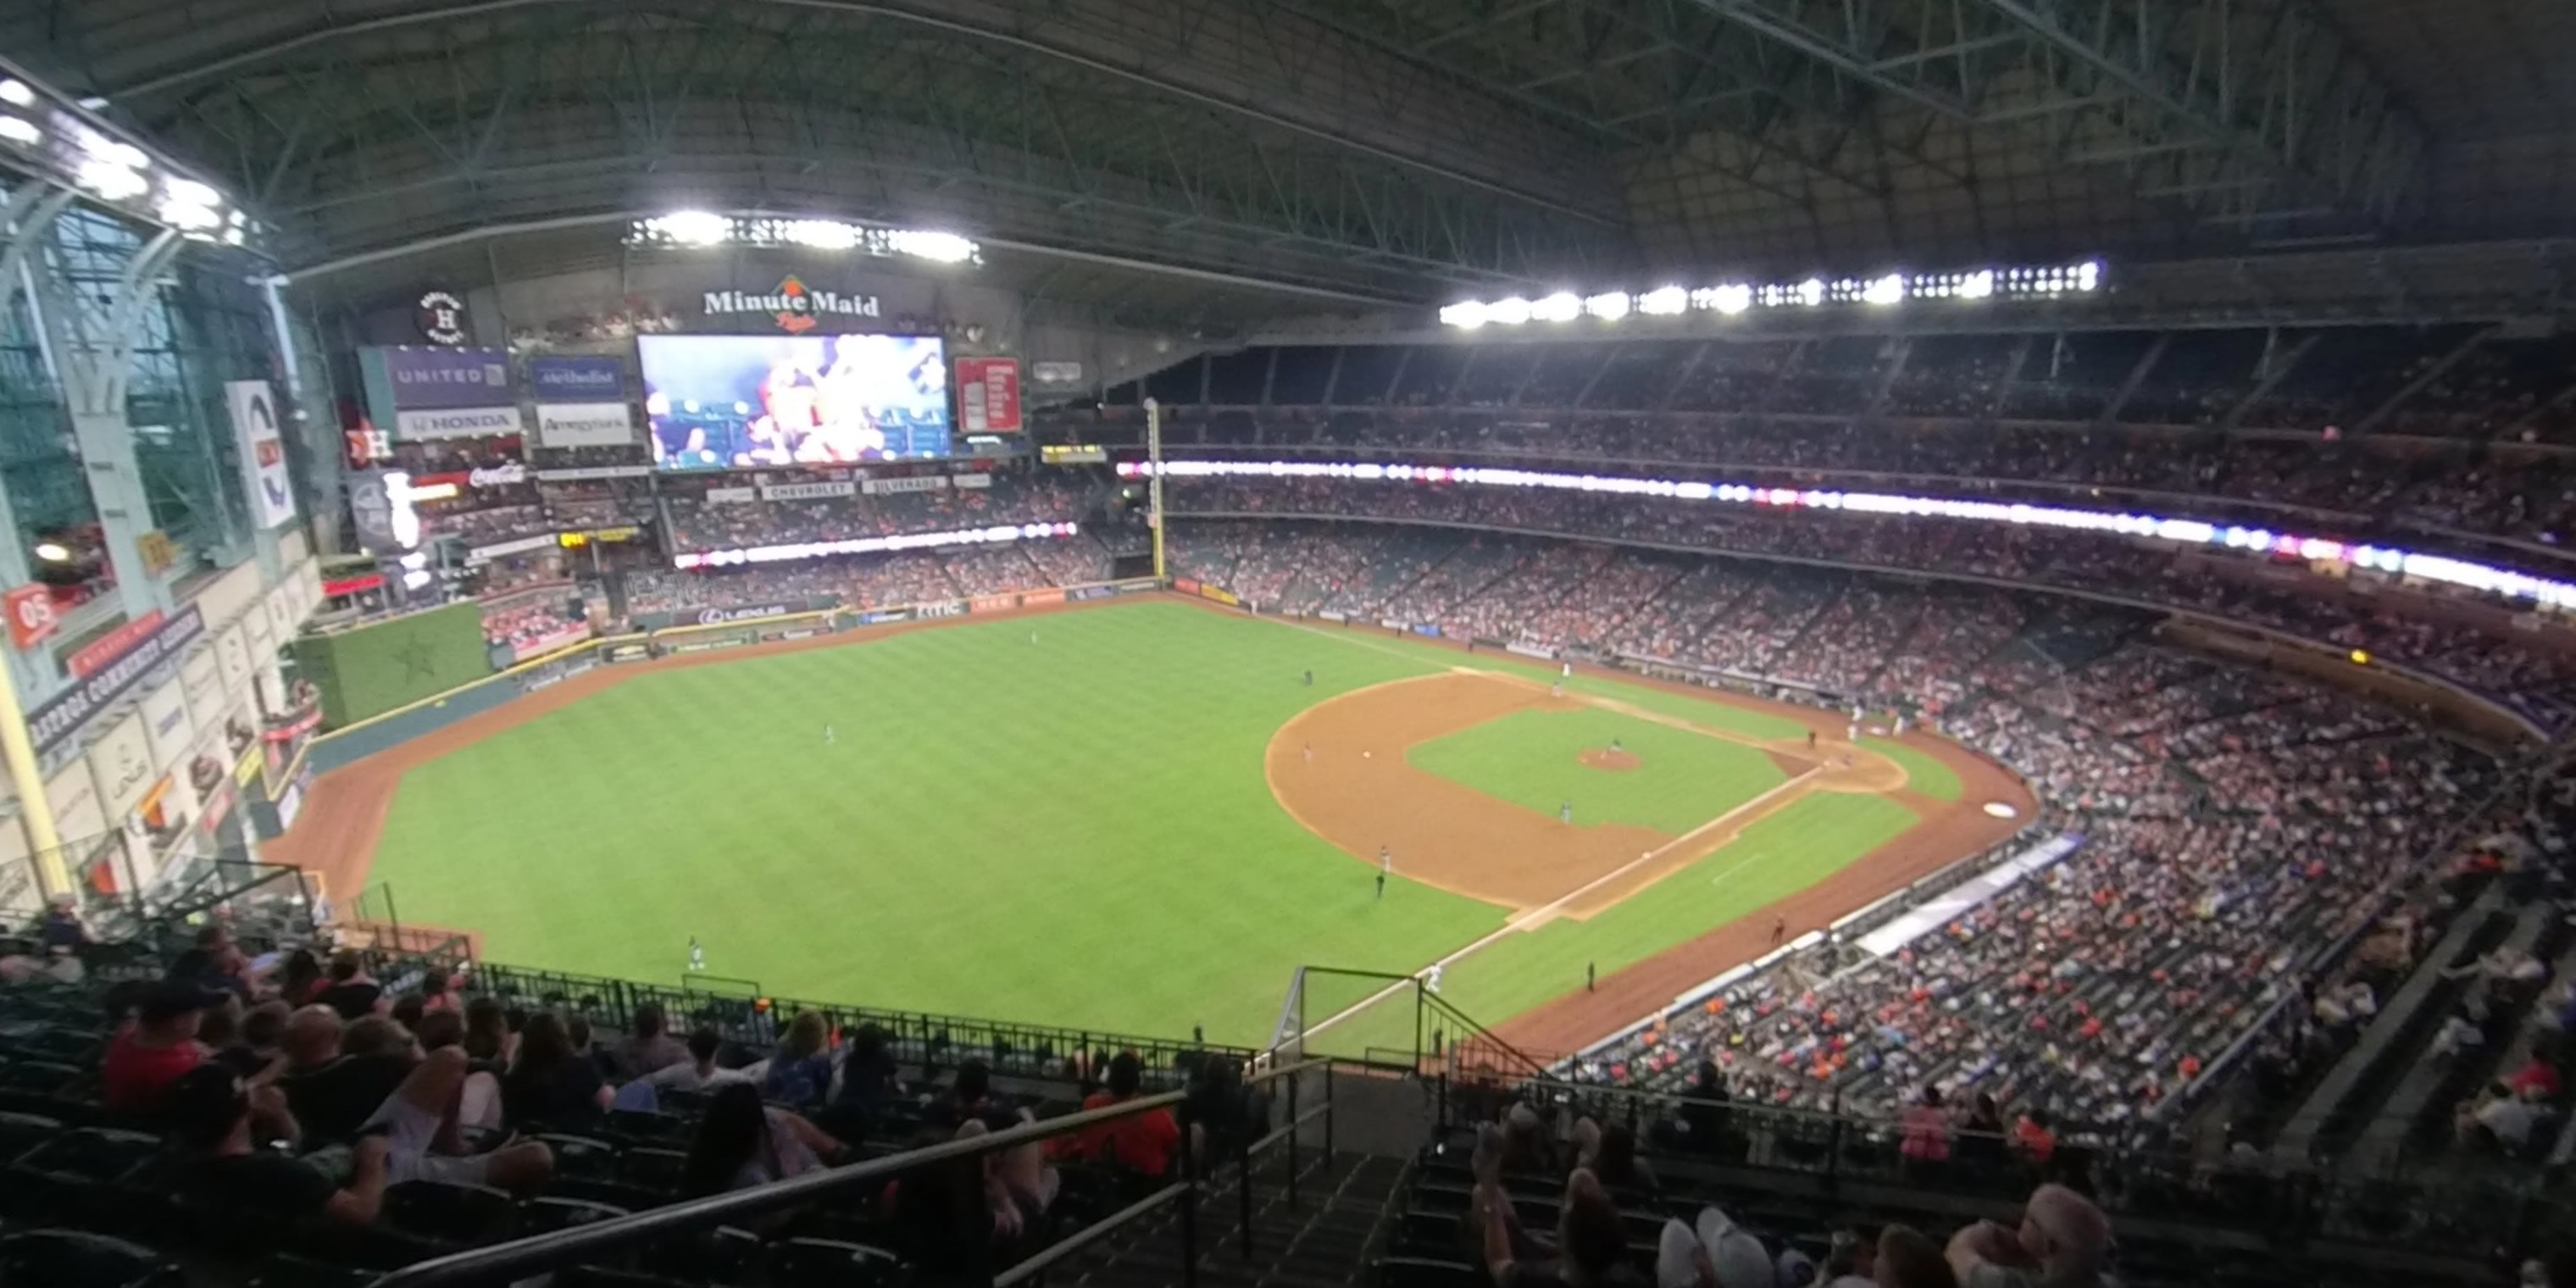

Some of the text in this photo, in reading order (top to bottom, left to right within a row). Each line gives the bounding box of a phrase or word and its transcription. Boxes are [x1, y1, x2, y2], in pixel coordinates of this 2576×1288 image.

[703, 291, 880, 317] Minute Maid
[436, 308, 456, 329] H
[397, 368, 482, 384] UNITED
[430, 414, 510, 430] HONDA
[770, 484, 846, 498] CHEVROLET
[872, 479, 939, 493] SILVERADO
[724, 605, 786, 619] LEXUS
